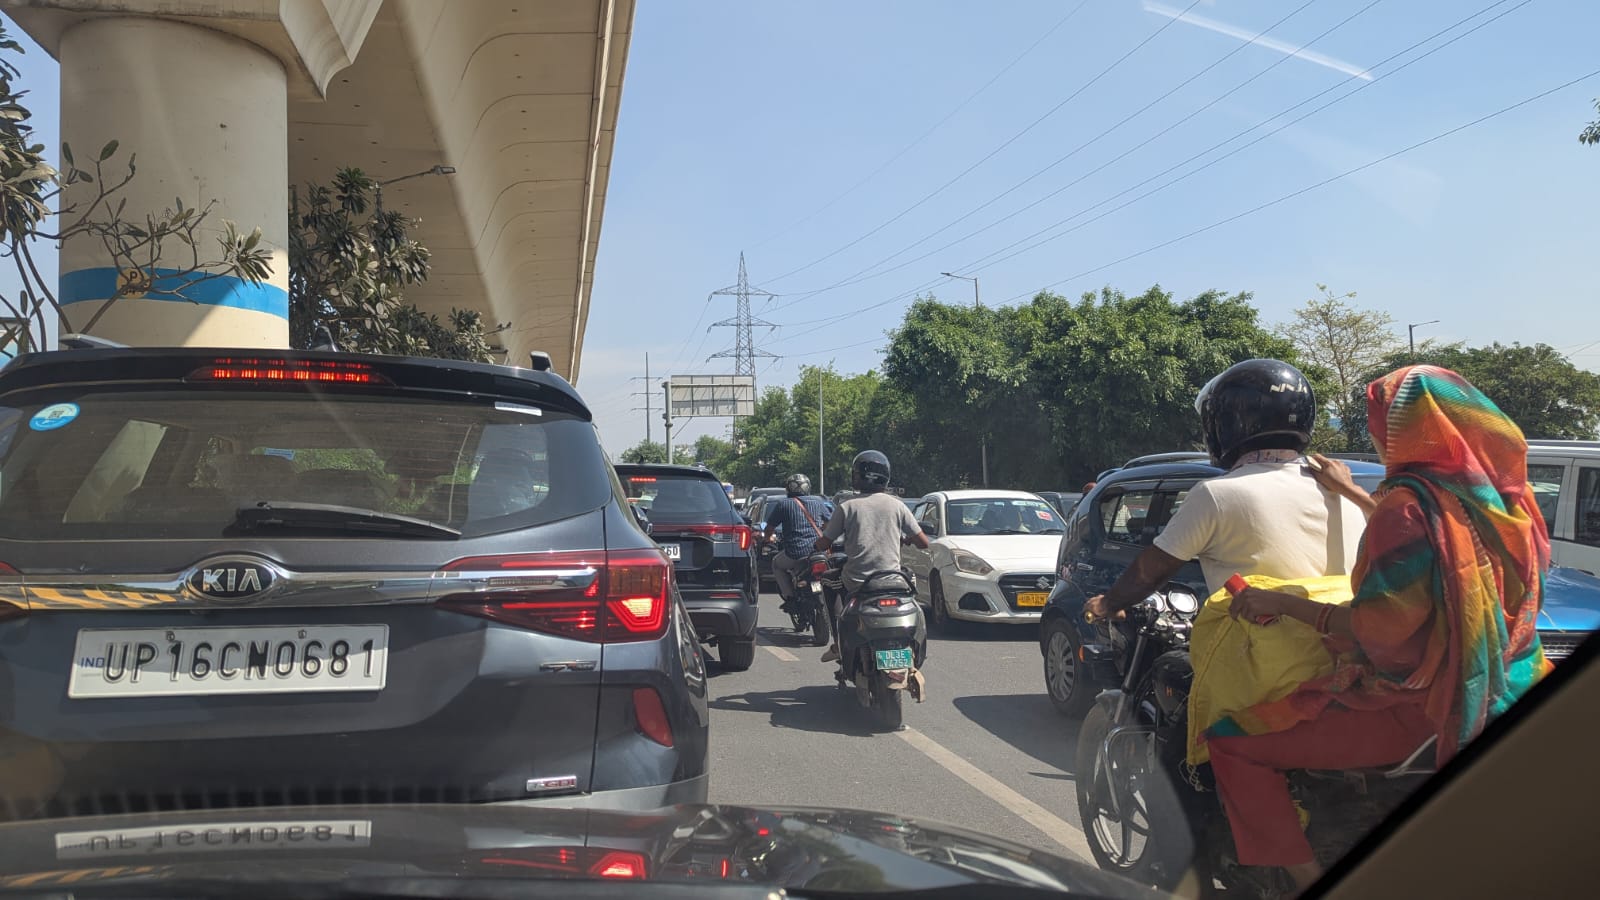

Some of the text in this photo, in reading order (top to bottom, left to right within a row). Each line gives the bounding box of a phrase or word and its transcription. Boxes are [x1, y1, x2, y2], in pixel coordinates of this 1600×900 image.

[202, 568, 262, 592] KIA
[80, 656, 105, 668] IND
[102, 638, 376, 683] UP16CN0681
